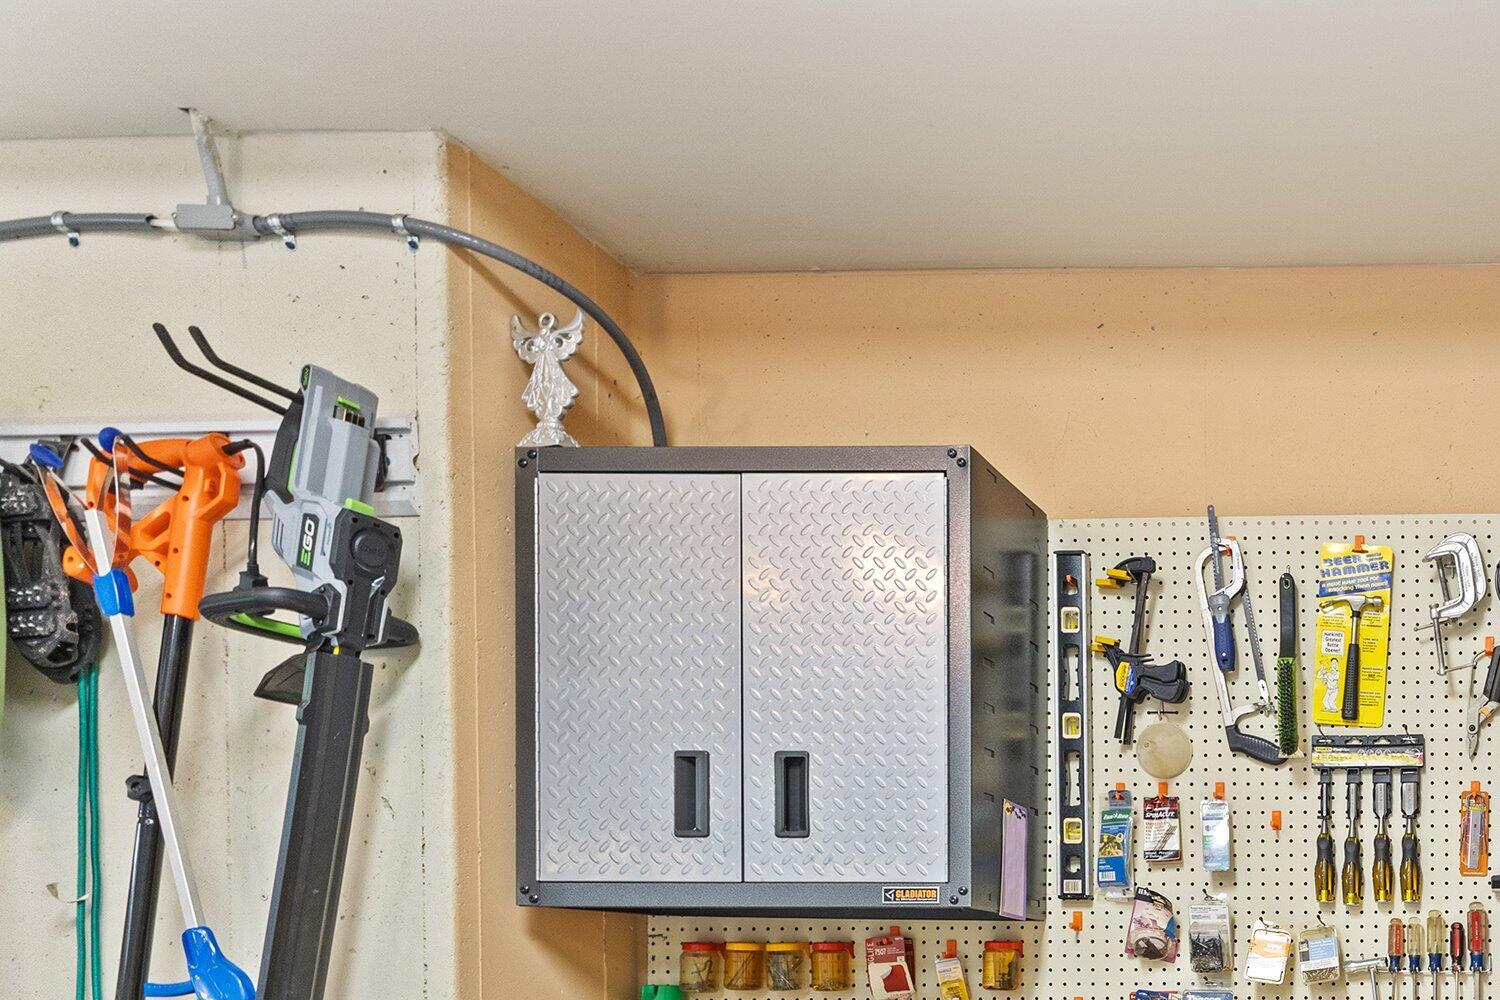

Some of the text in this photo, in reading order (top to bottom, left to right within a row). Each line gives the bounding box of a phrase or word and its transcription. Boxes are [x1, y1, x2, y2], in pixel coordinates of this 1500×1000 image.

[300, 519, 315, 567] EGO
[1322, 554, 1361, 567] BEER
[1320, 560, 1390, 578] HAMMER
[895, 889, 937, 898] GLADIATOR
